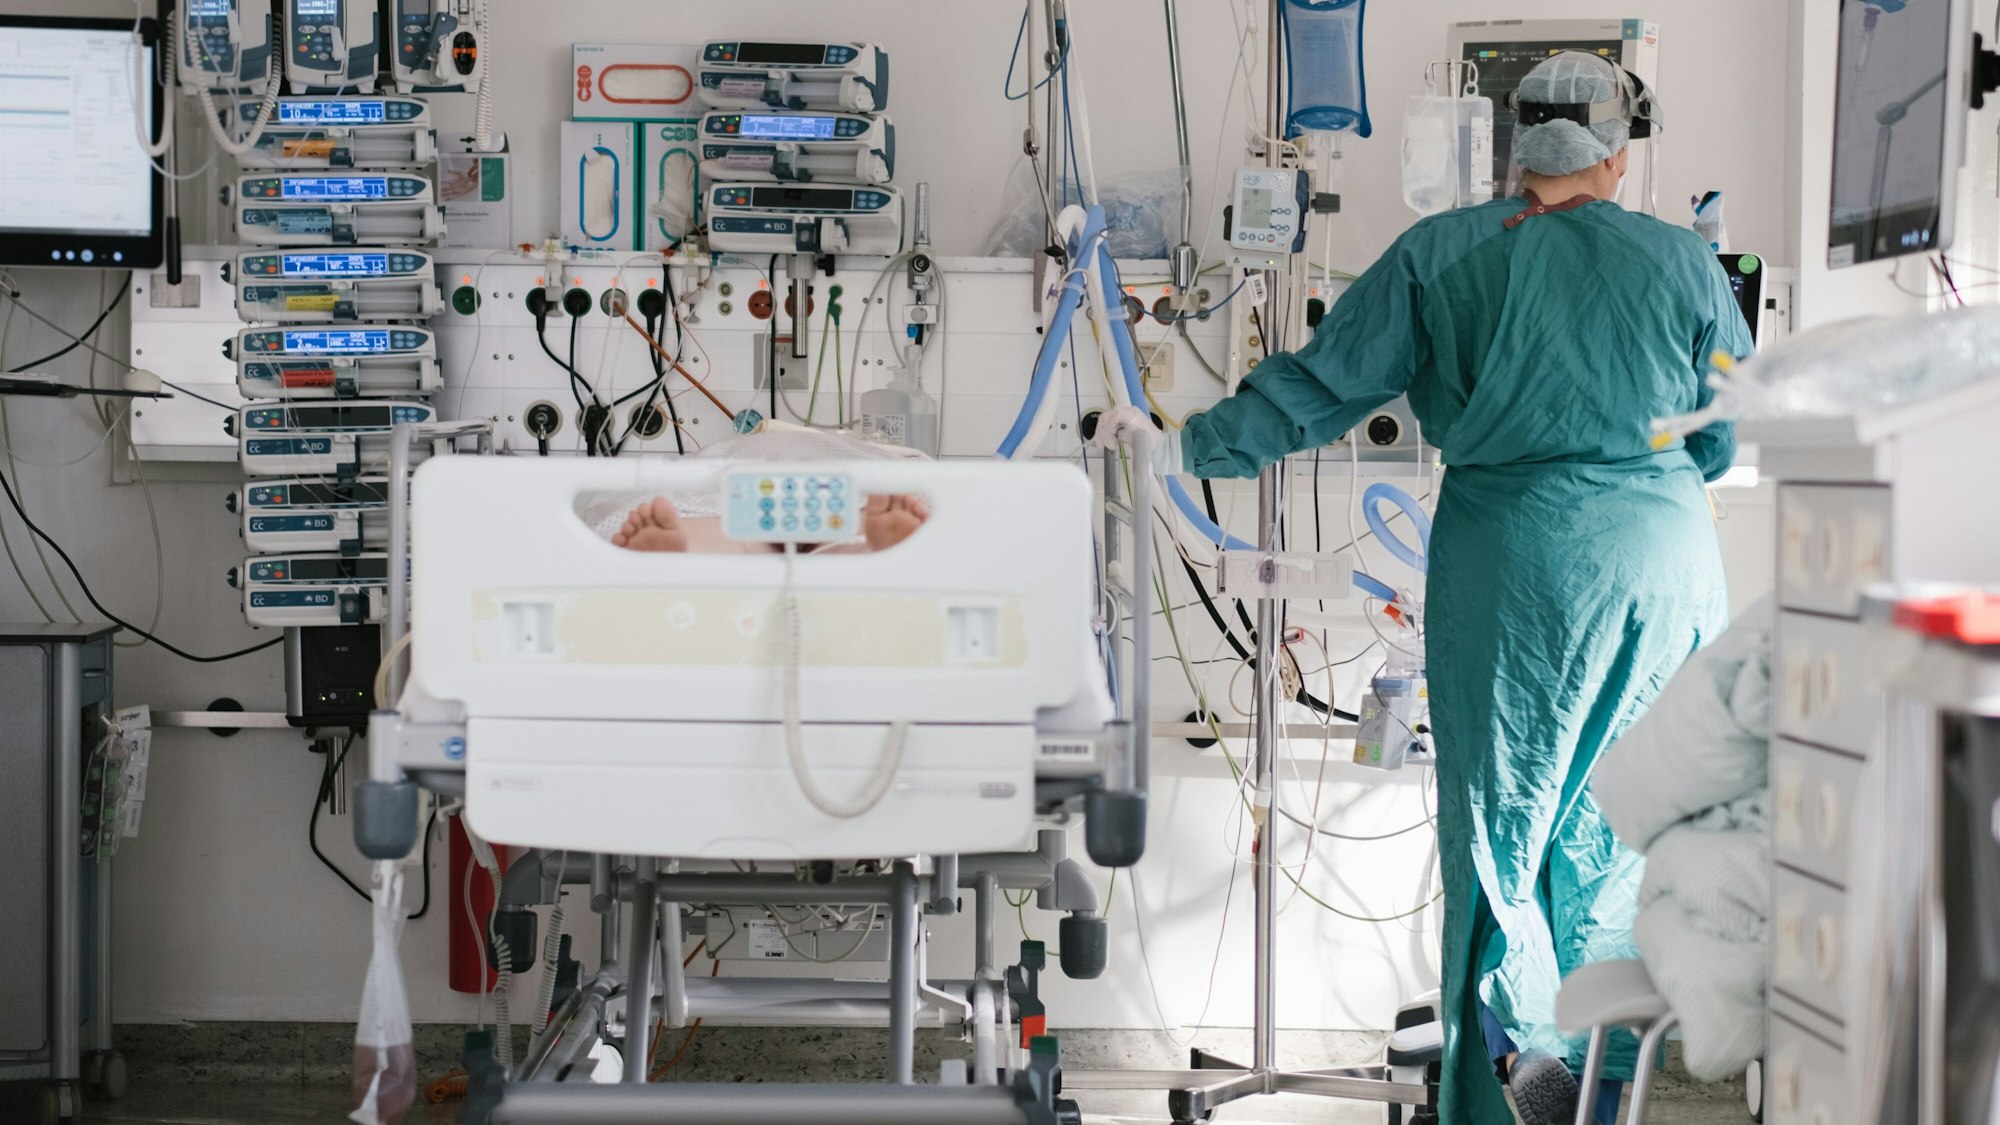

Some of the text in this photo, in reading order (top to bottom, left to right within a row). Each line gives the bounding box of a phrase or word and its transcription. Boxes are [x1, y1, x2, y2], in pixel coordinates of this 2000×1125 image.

[705, 150, 716, 158] CC
[245, 214, 258, 222] CC
[714, 223, 787, 231] CC BD
[247, 368, 259, 377] CC
[249, 442, 325, 453] CC BD
[252, 519, 328, 530] CC BD
[253, 594, 329, 606] CC BD
